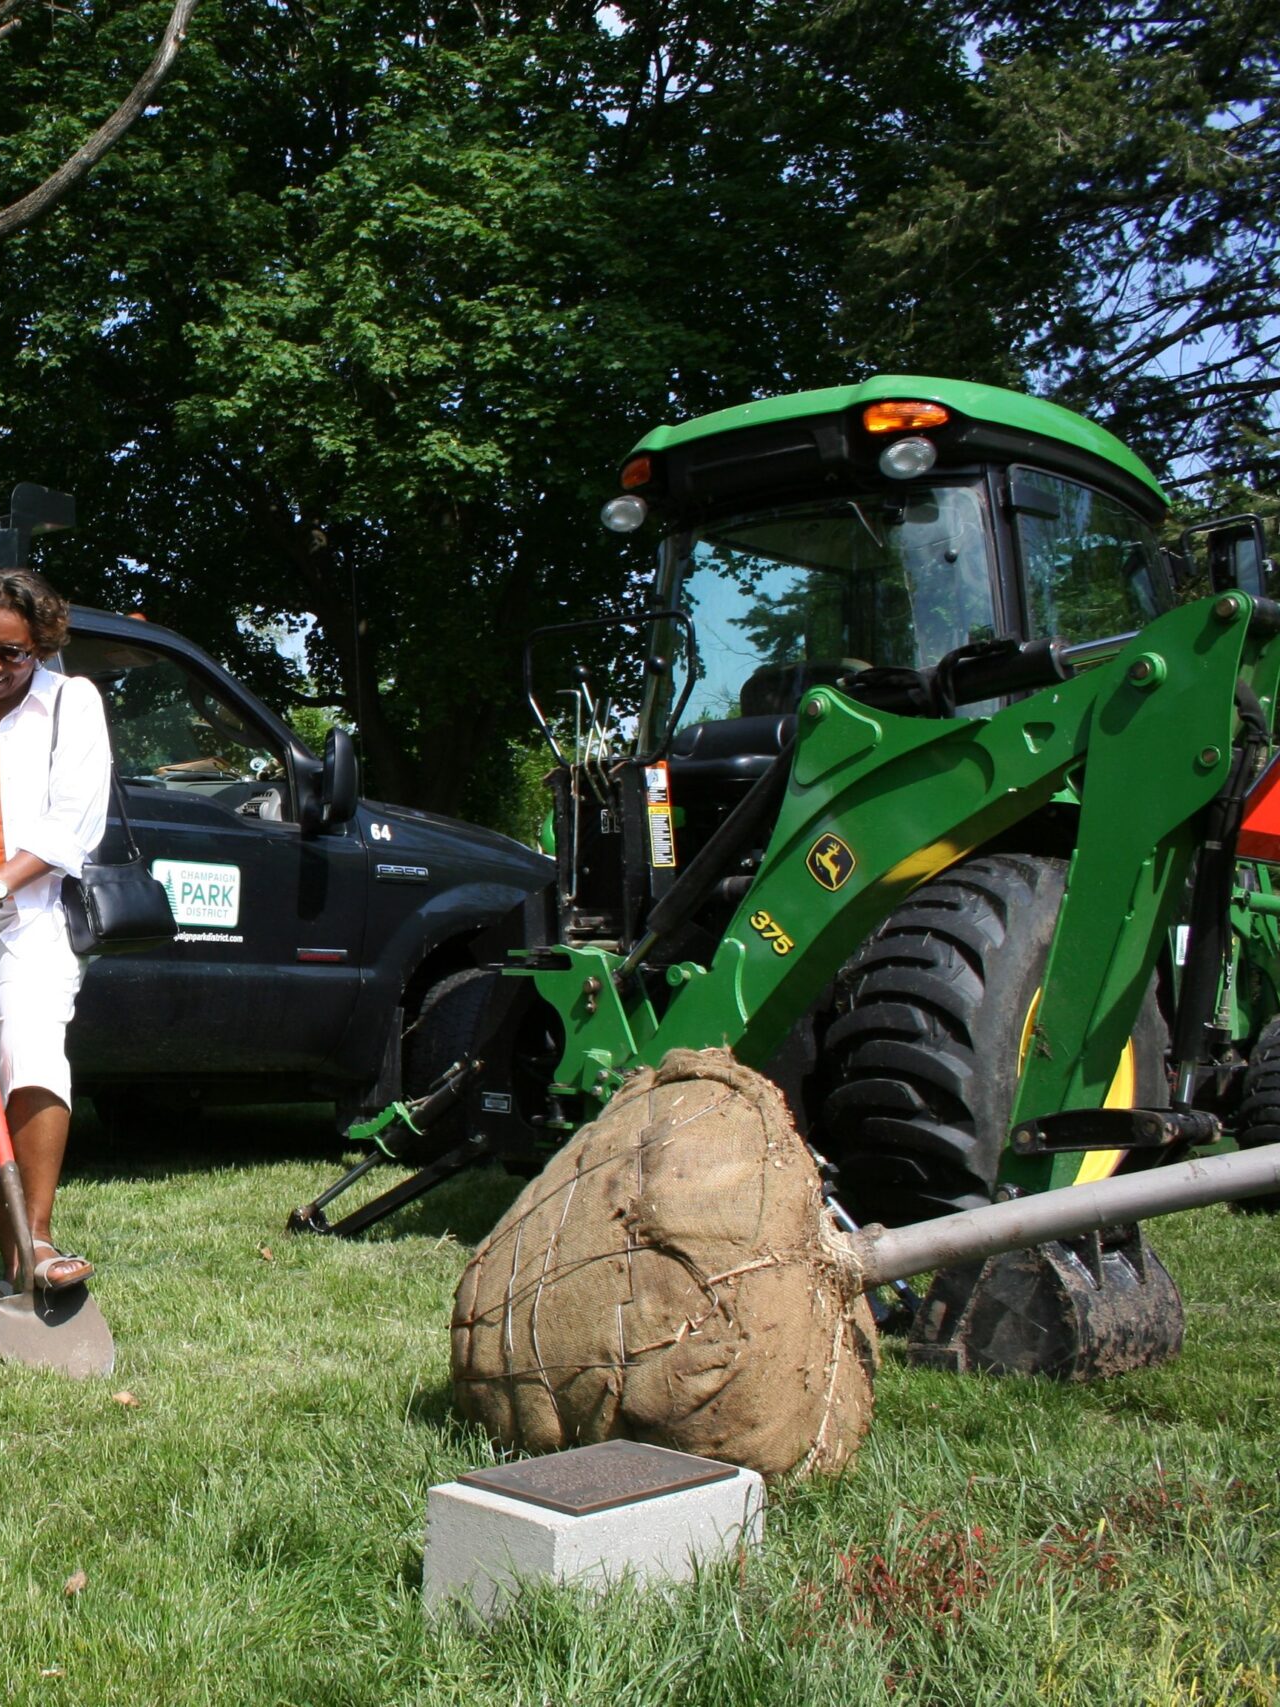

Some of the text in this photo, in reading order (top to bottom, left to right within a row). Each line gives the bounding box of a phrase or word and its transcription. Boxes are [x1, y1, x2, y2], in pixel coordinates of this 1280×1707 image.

[371, 823, 391, 841] 64
[181, 870, 236, 883] CHAMPAIGN
[181, 882, 234, 908] PARK
[186, 907, 229, 918] DISTRICT
[750, 910, 795, 956] 375
